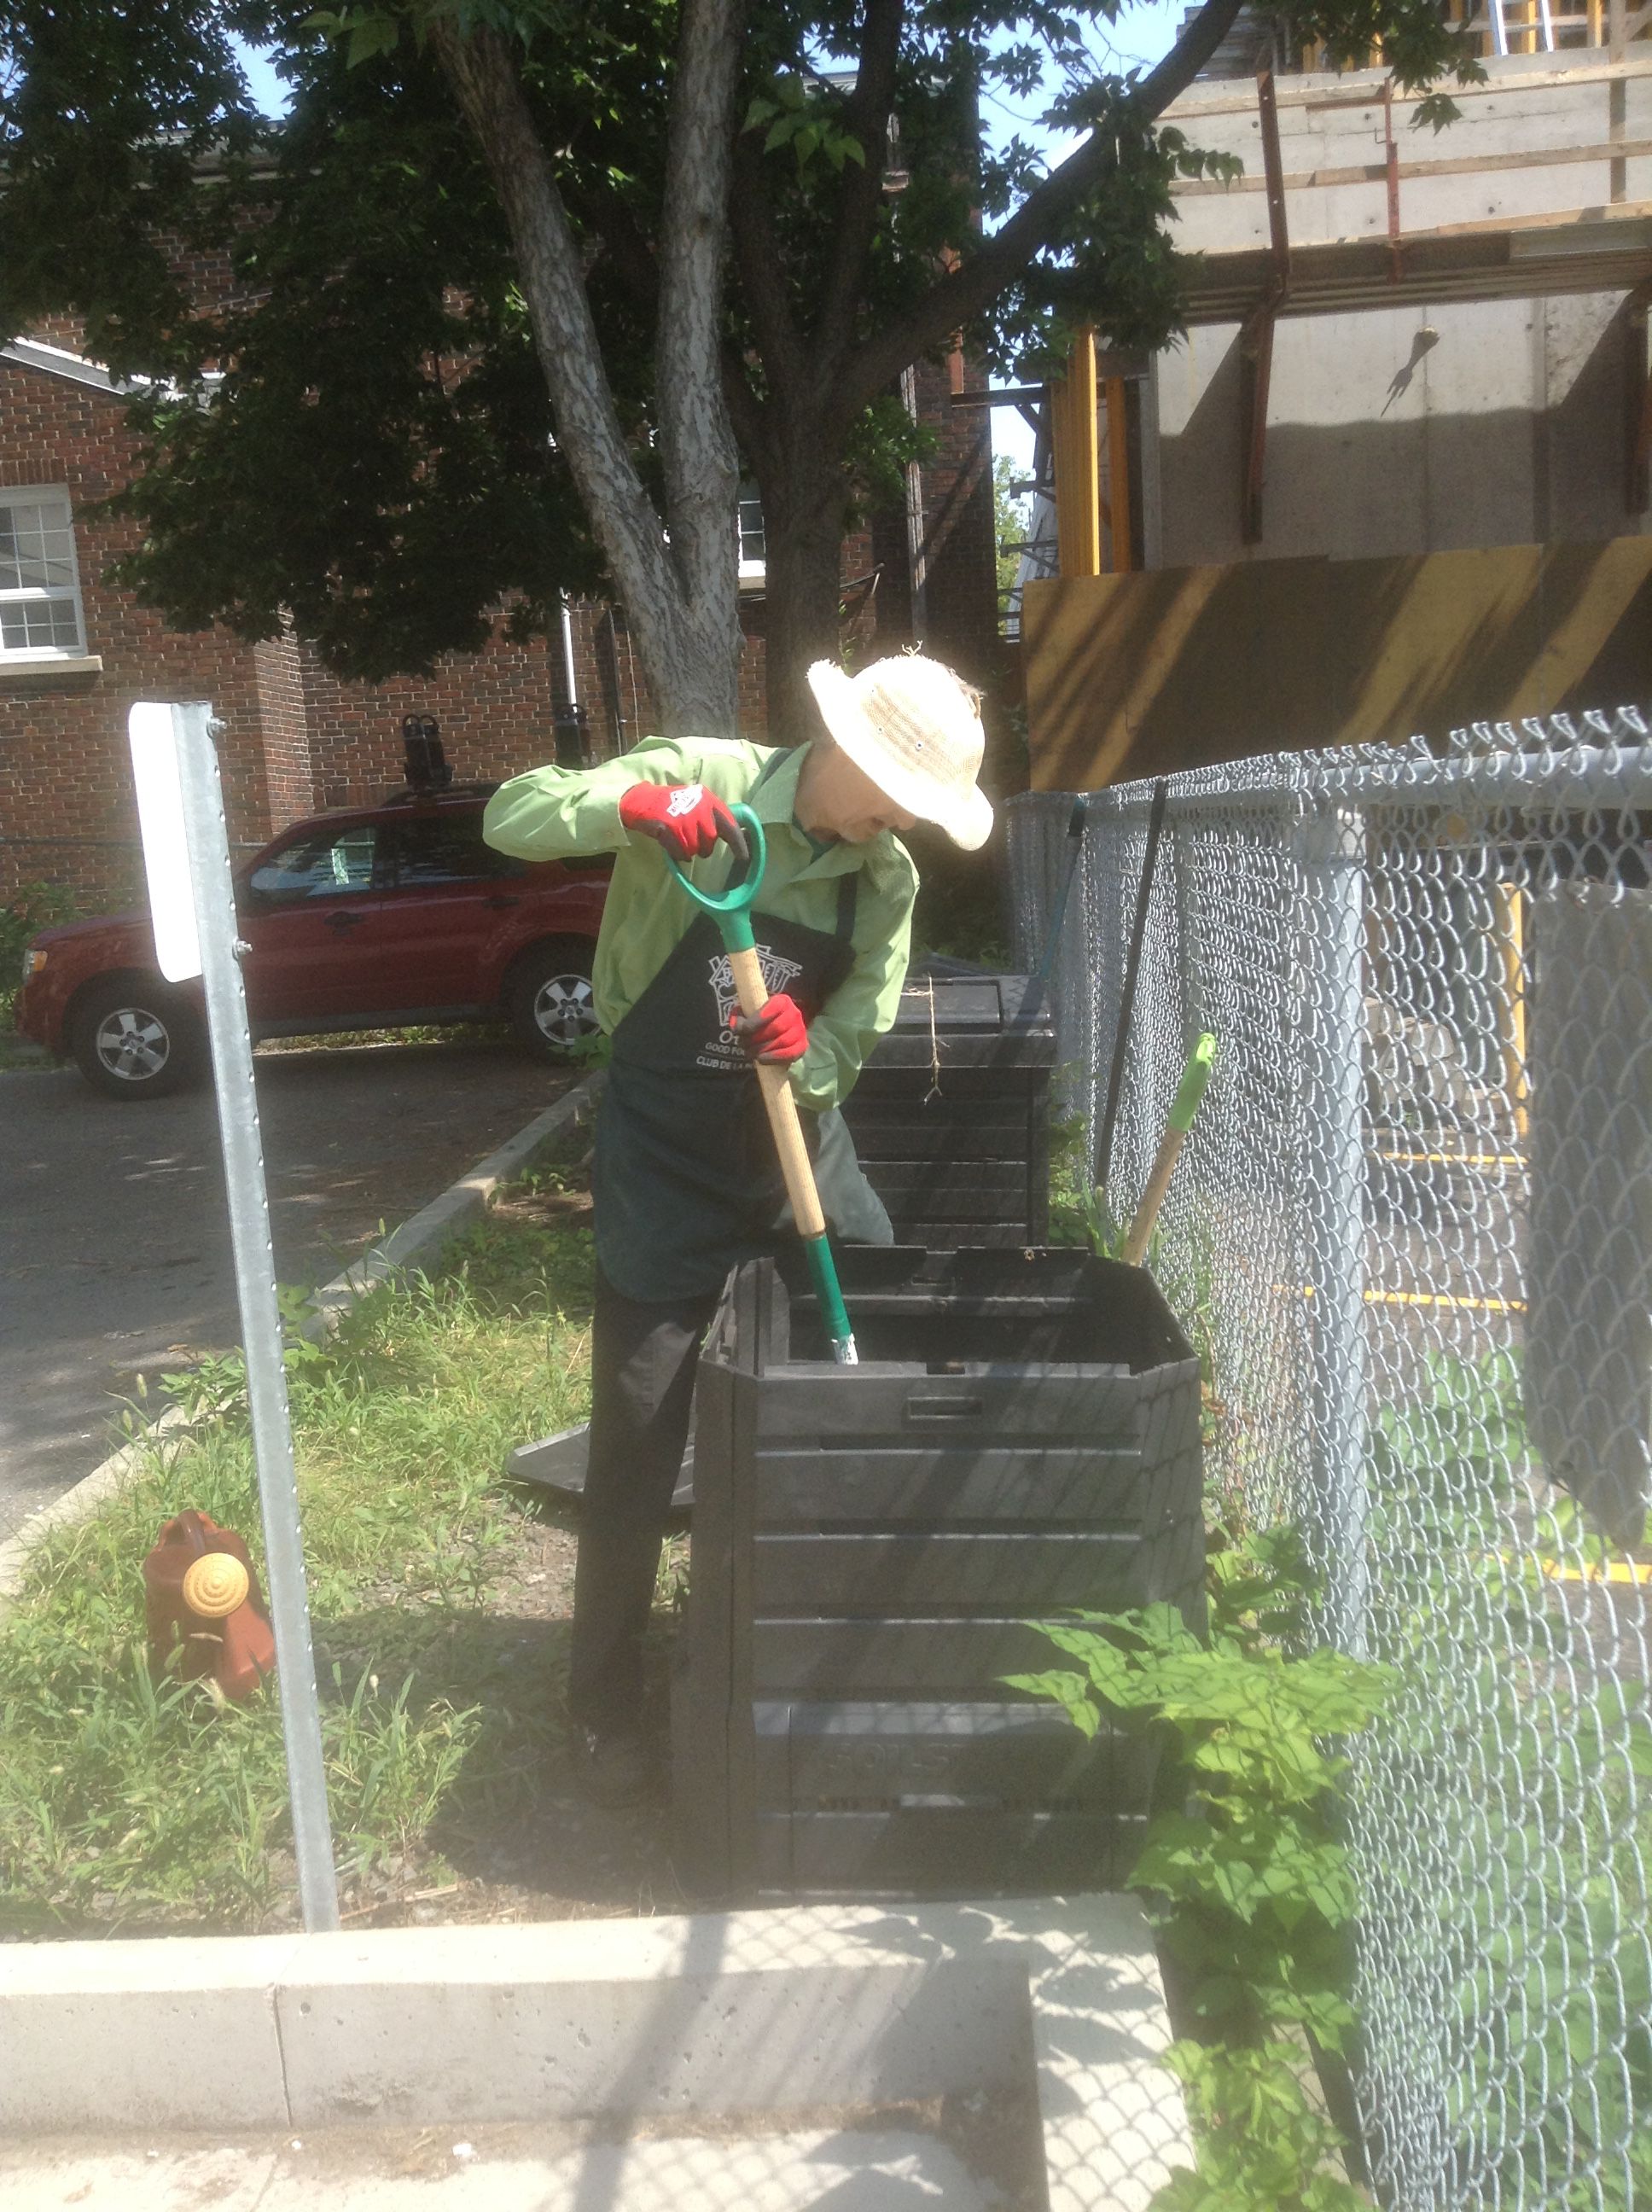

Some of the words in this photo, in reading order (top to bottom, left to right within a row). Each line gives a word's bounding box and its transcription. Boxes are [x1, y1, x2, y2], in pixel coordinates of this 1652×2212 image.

[705, 1042, 730, 1054] GOOD
[696, 1056, 718, 1068] CLUB
[720, 1061, 731, 1069] DE
